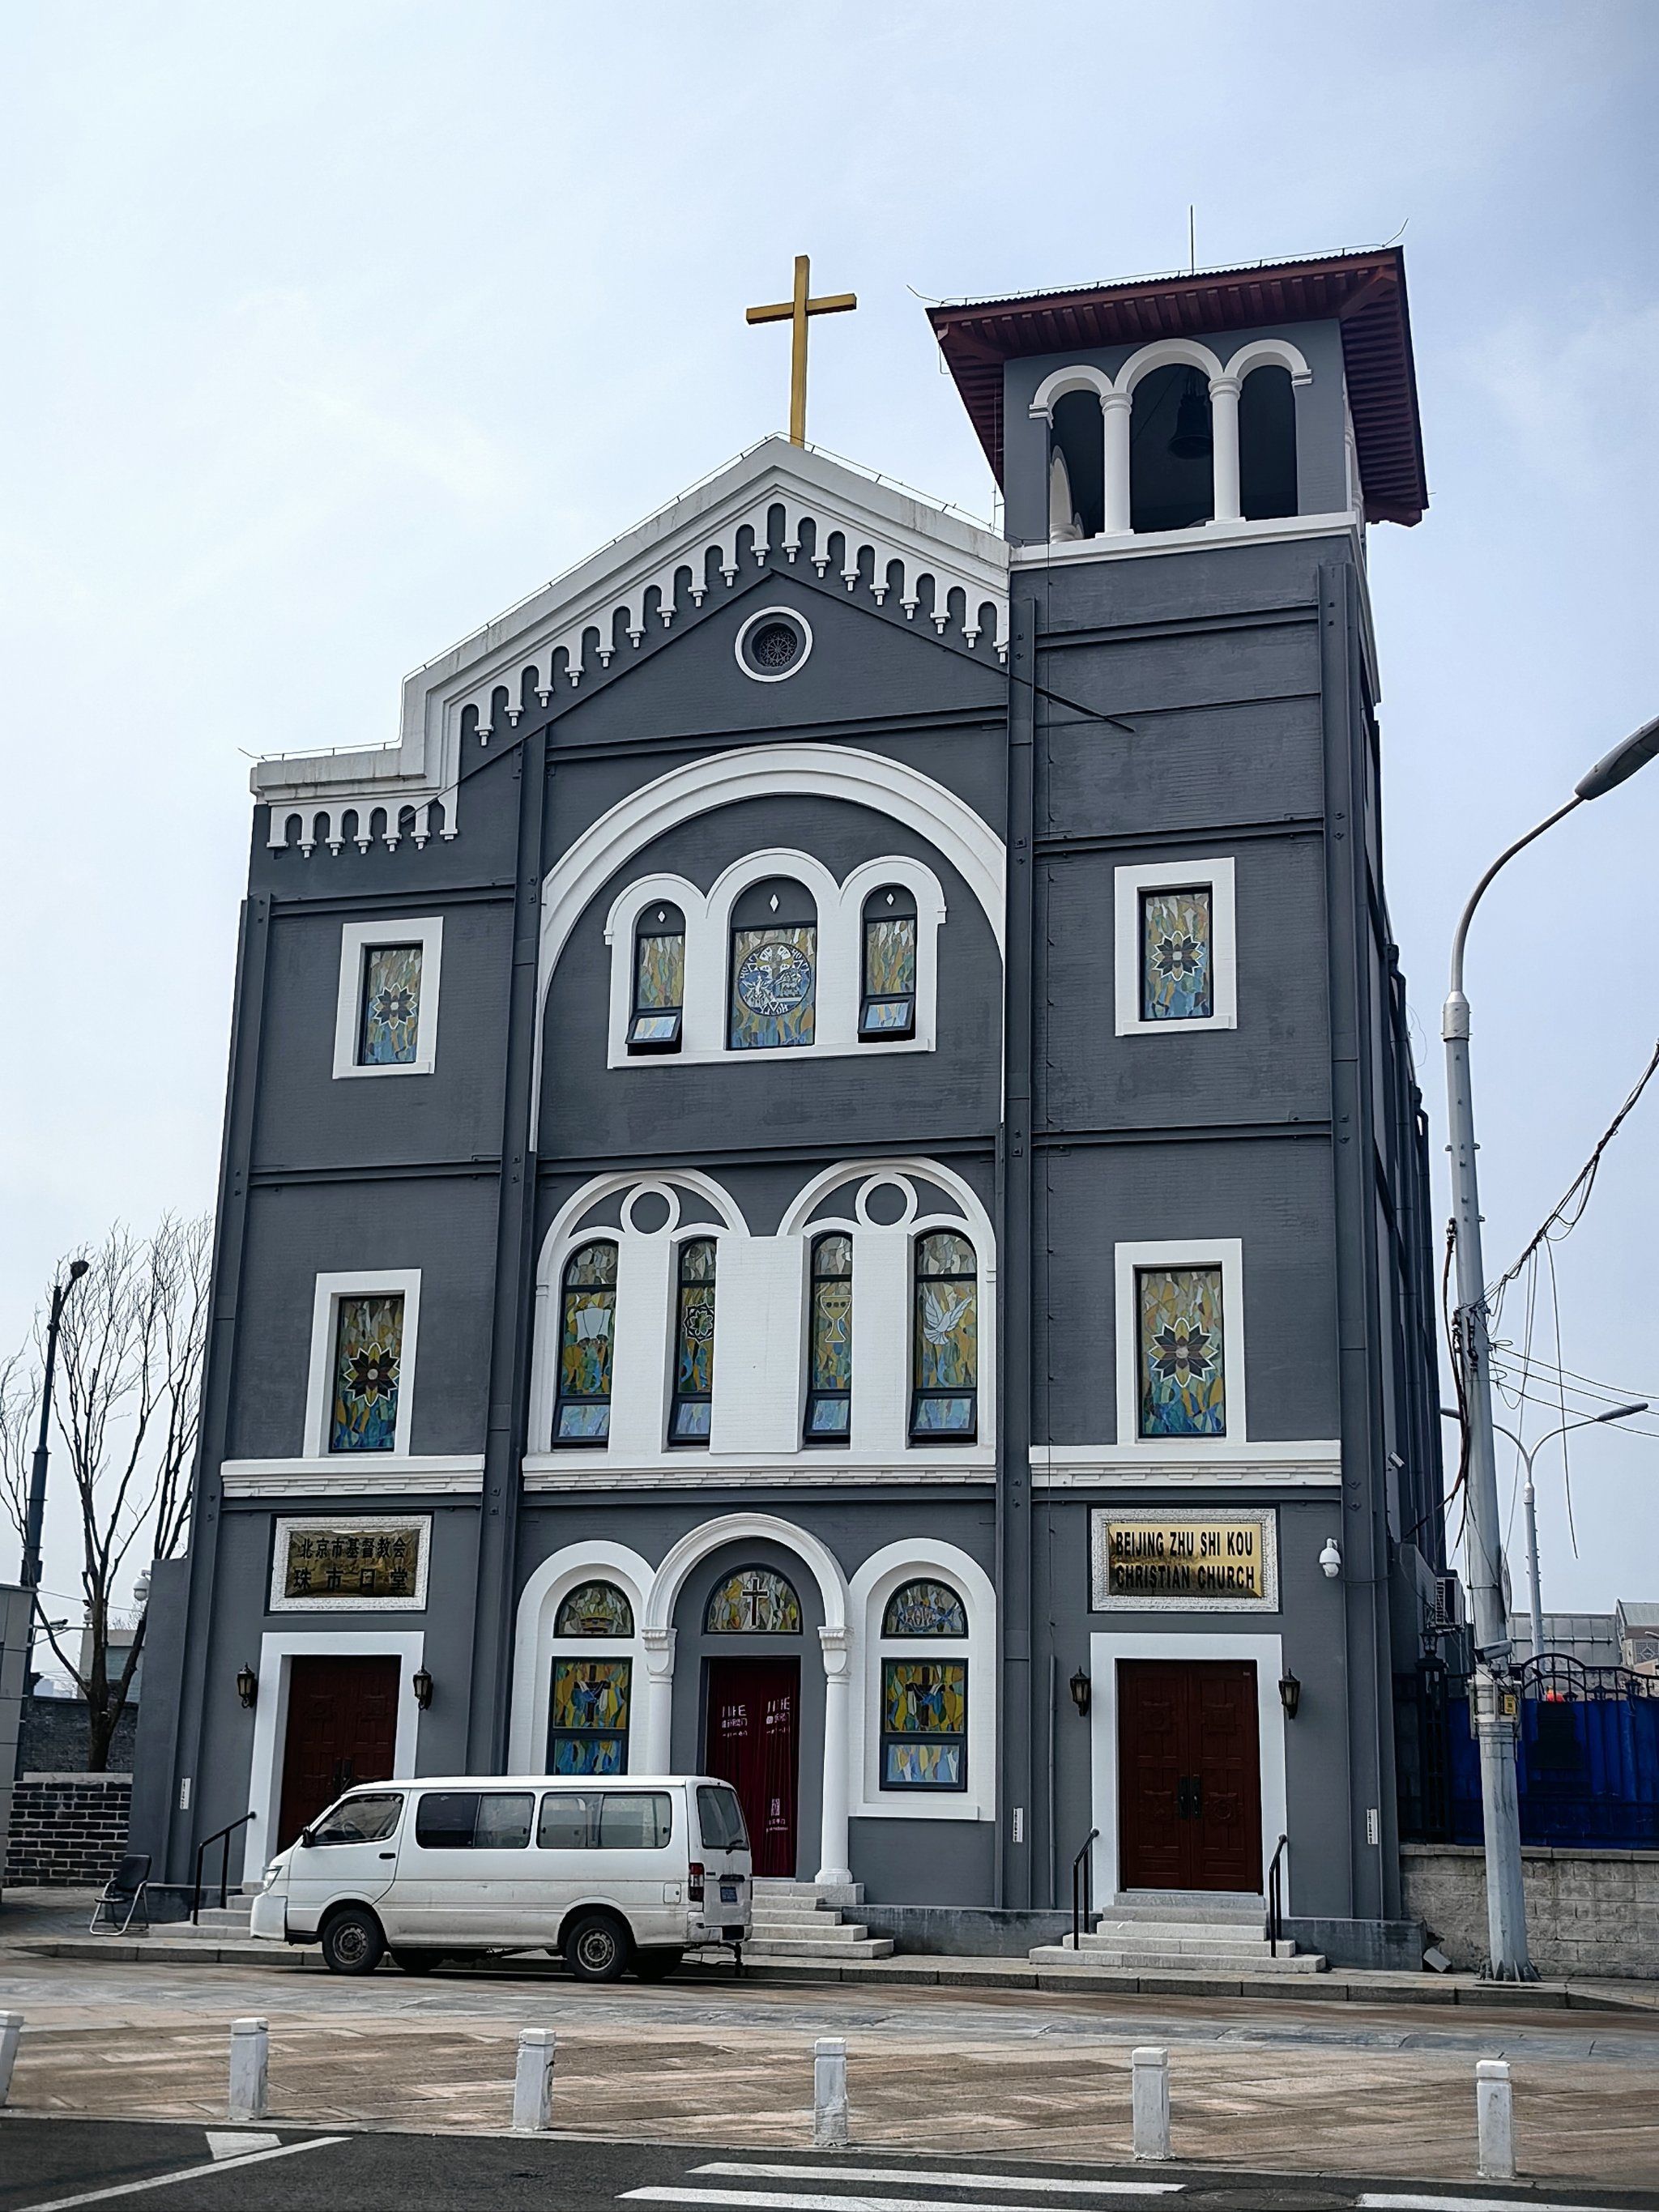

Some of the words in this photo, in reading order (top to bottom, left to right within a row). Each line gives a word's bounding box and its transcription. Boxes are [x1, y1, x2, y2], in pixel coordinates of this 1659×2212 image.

[300, 1537, 406, 1559] 北京市基督教会
[1115, 1532, 1163, 1556] BEIJING
[1170, 1532, 1194, 1556] ZHU
[1201, 1532, 1220, 1556] SHI
[1227, 1532, 1252, 1556] KOU
[293, 1566, 407, 1591] 珠市口堂
[1115, 1565, 1190, 1588] CHRISTIAN
[1198, 1566, 1255, 1589] CHURCH
